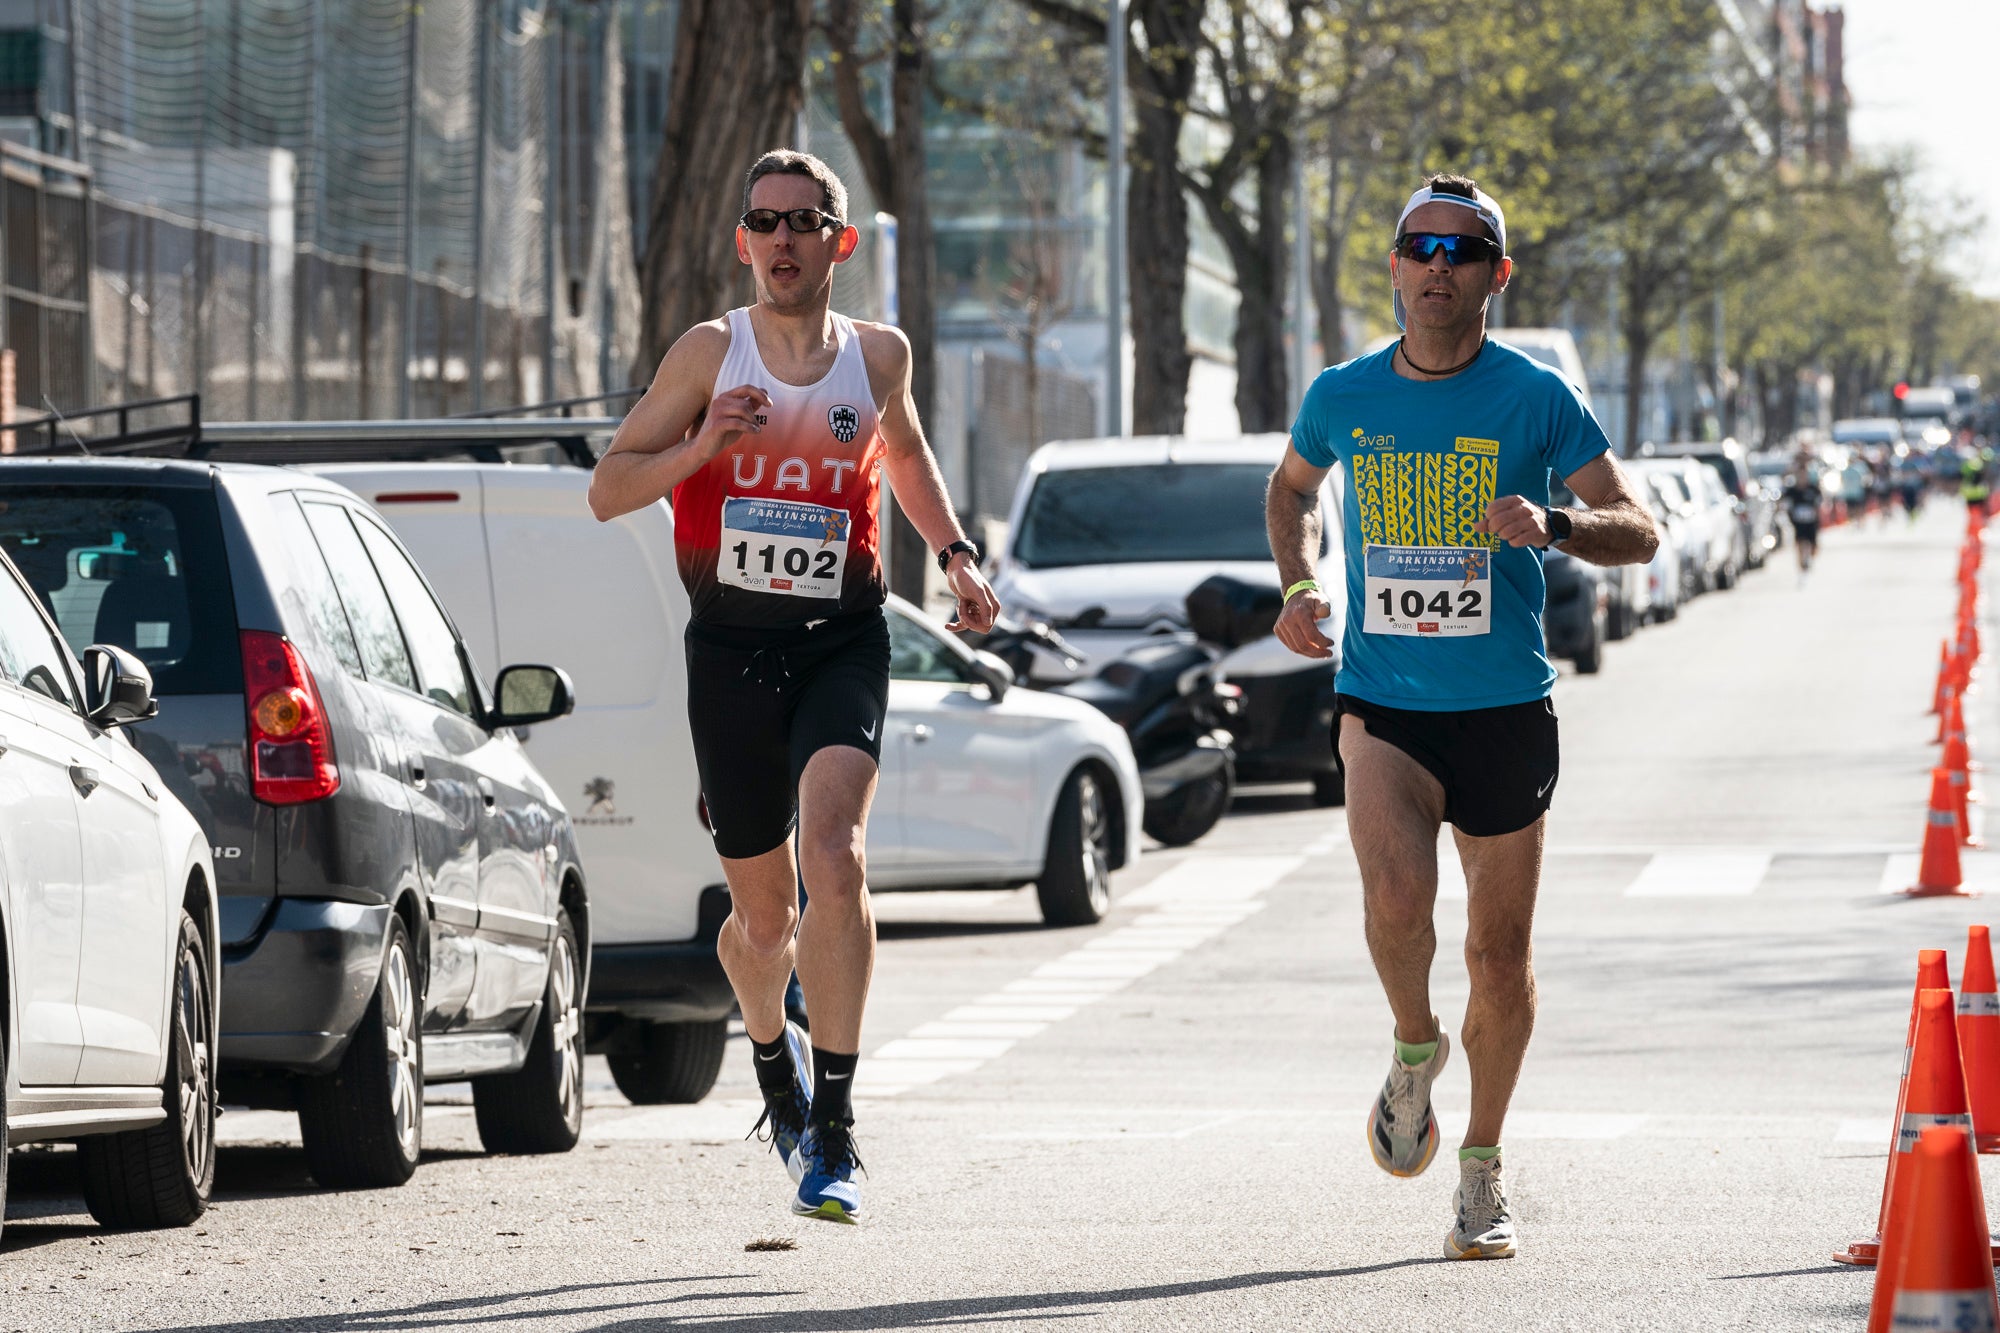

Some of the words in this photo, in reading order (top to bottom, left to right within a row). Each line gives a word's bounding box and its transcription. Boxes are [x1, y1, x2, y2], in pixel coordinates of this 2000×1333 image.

[1358, 434, 1395, 447] avan
[1467, 444, 1496, 454] Terrassa
[1352, 452, 1498, 475] PARKINSON
[731, 453, 857, 494] UAT
[747, 507, 827, 524] PARKINSON
[732, 540, 838, 580] 1102
[1388, 555, 1465, 565] PARKINSON
[743, 576, 765, 586] avan
[1377, 587, 1482, 618] 1042
[1392, 621, 1413, 630] avan
